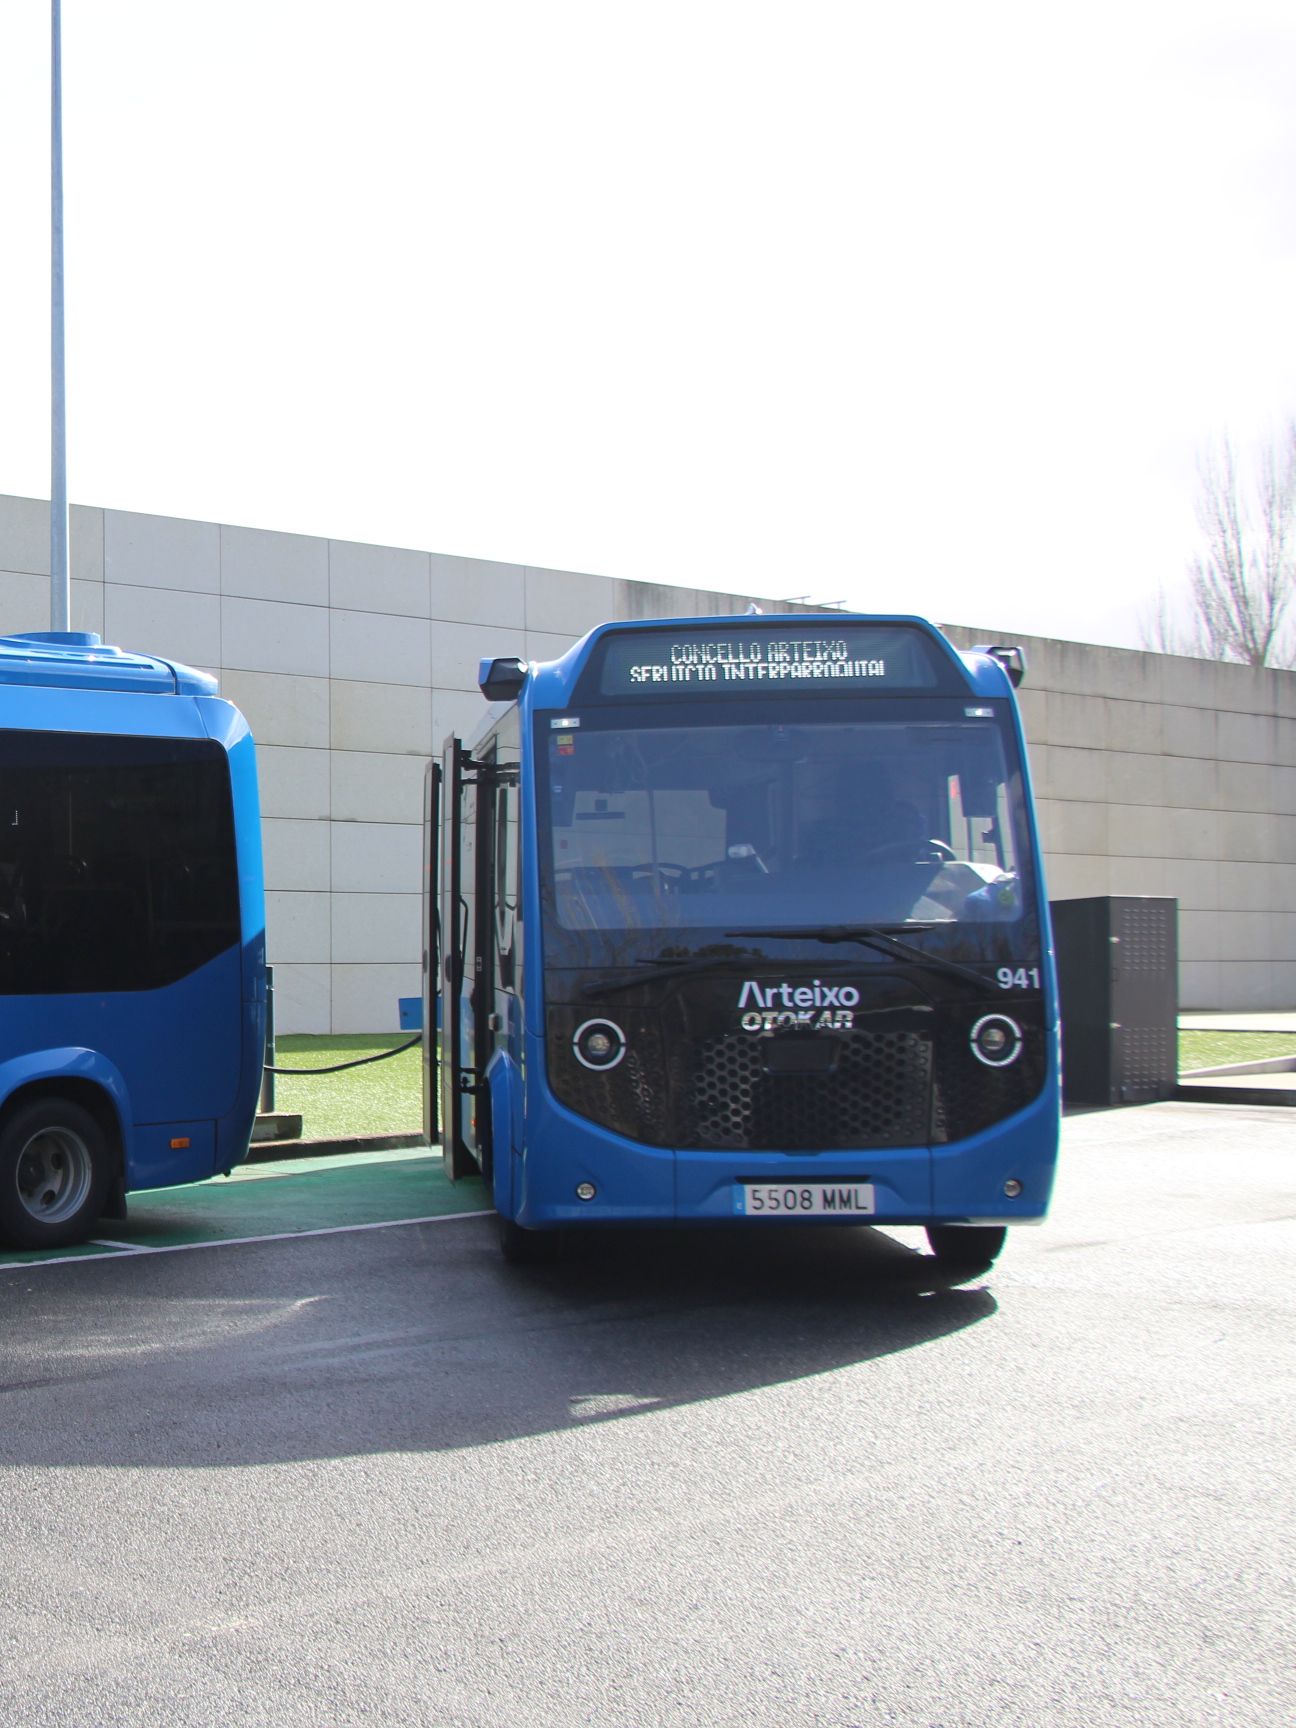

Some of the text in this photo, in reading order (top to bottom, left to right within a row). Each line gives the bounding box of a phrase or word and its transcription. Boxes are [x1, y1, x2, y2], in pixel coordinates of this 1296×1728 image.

[671, 640, 848, 664] CONCELLO ARTEIXO
[996, 967, 1041, 990] 941
[737, 979, 861, 1008] Arteixo
[740, 1010, 855, 1032] OTOKAR
[750, 1189, 868, 1210] 5508 MML
